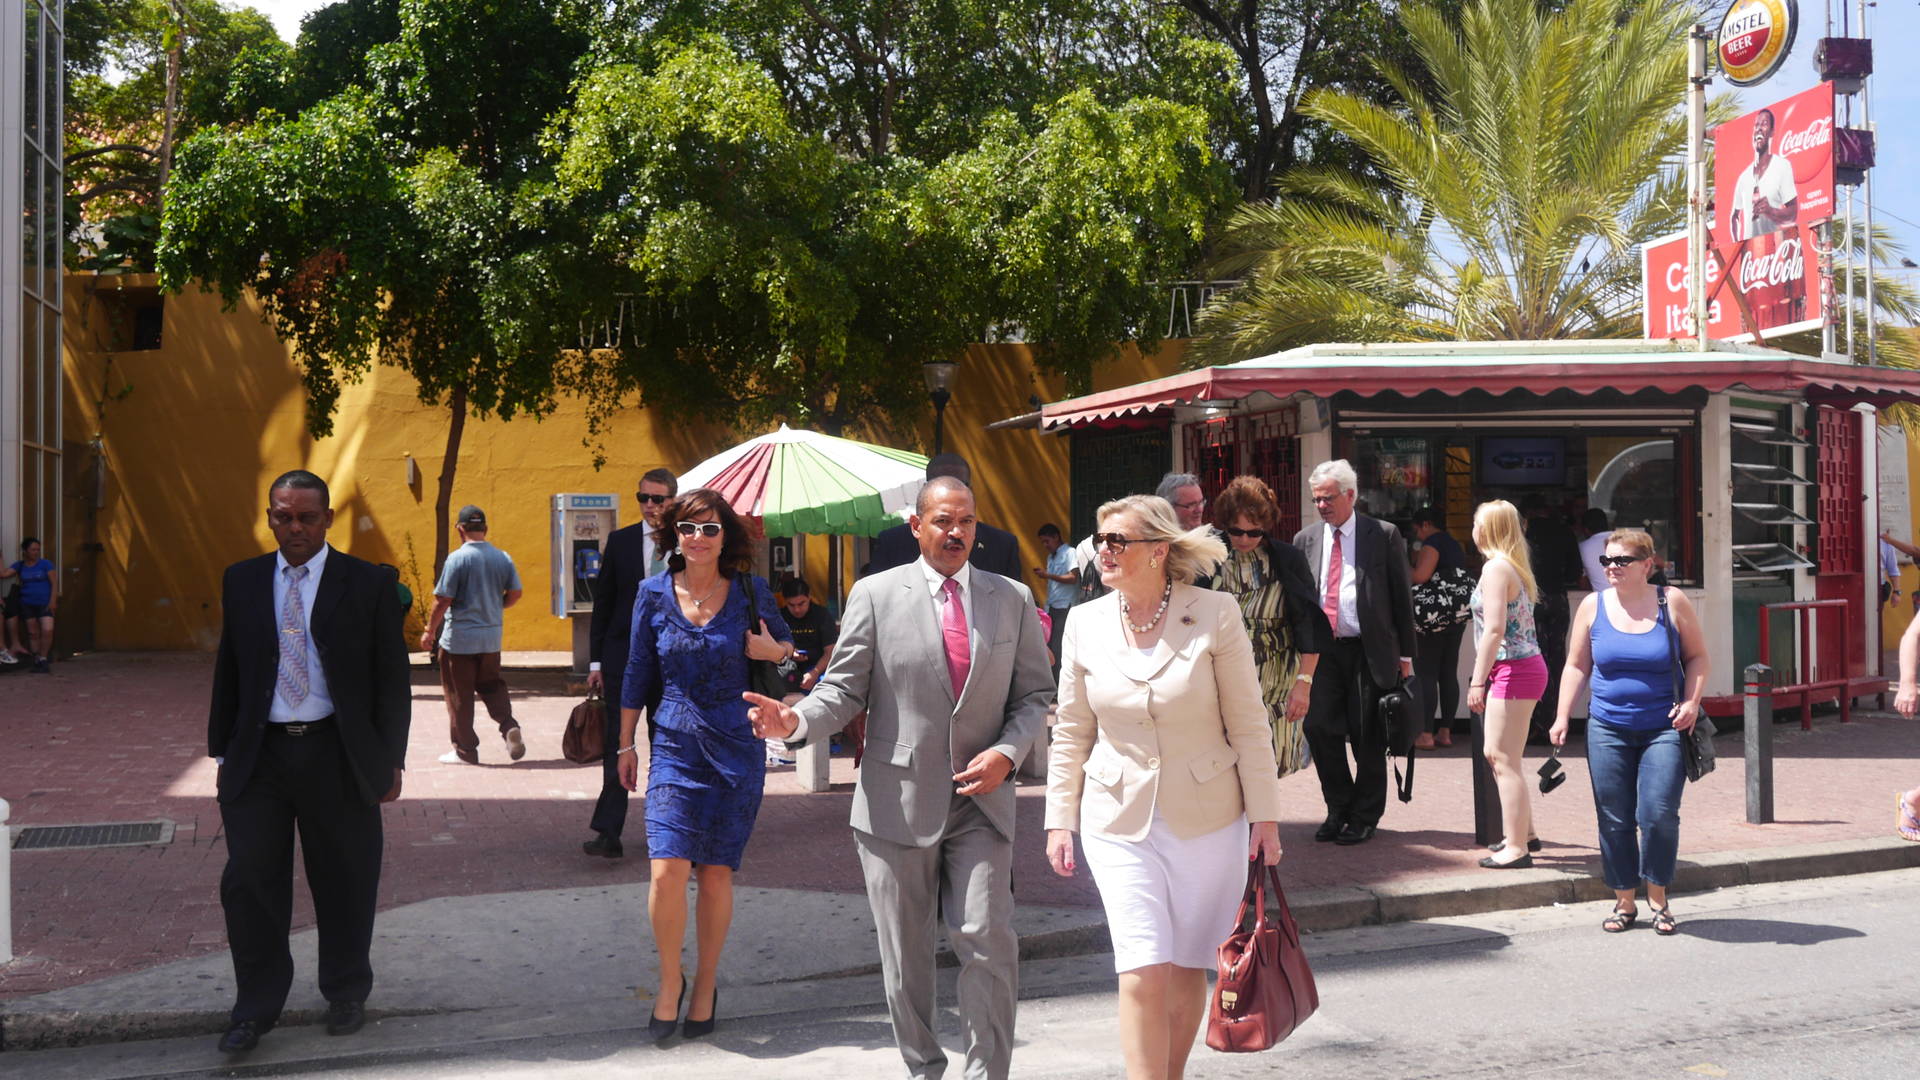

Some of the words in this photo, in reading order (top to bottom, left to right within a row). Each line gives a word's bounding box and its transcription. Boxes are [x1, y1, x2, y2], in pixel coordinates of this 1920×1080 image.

[1722, 12, 1766, 40] AMSTEL
[1727, 34, 1753, 55] BEER
[1666, 251, 1719, 293] Caé
[1740, 238, 1804, 294] Coca-Cola
